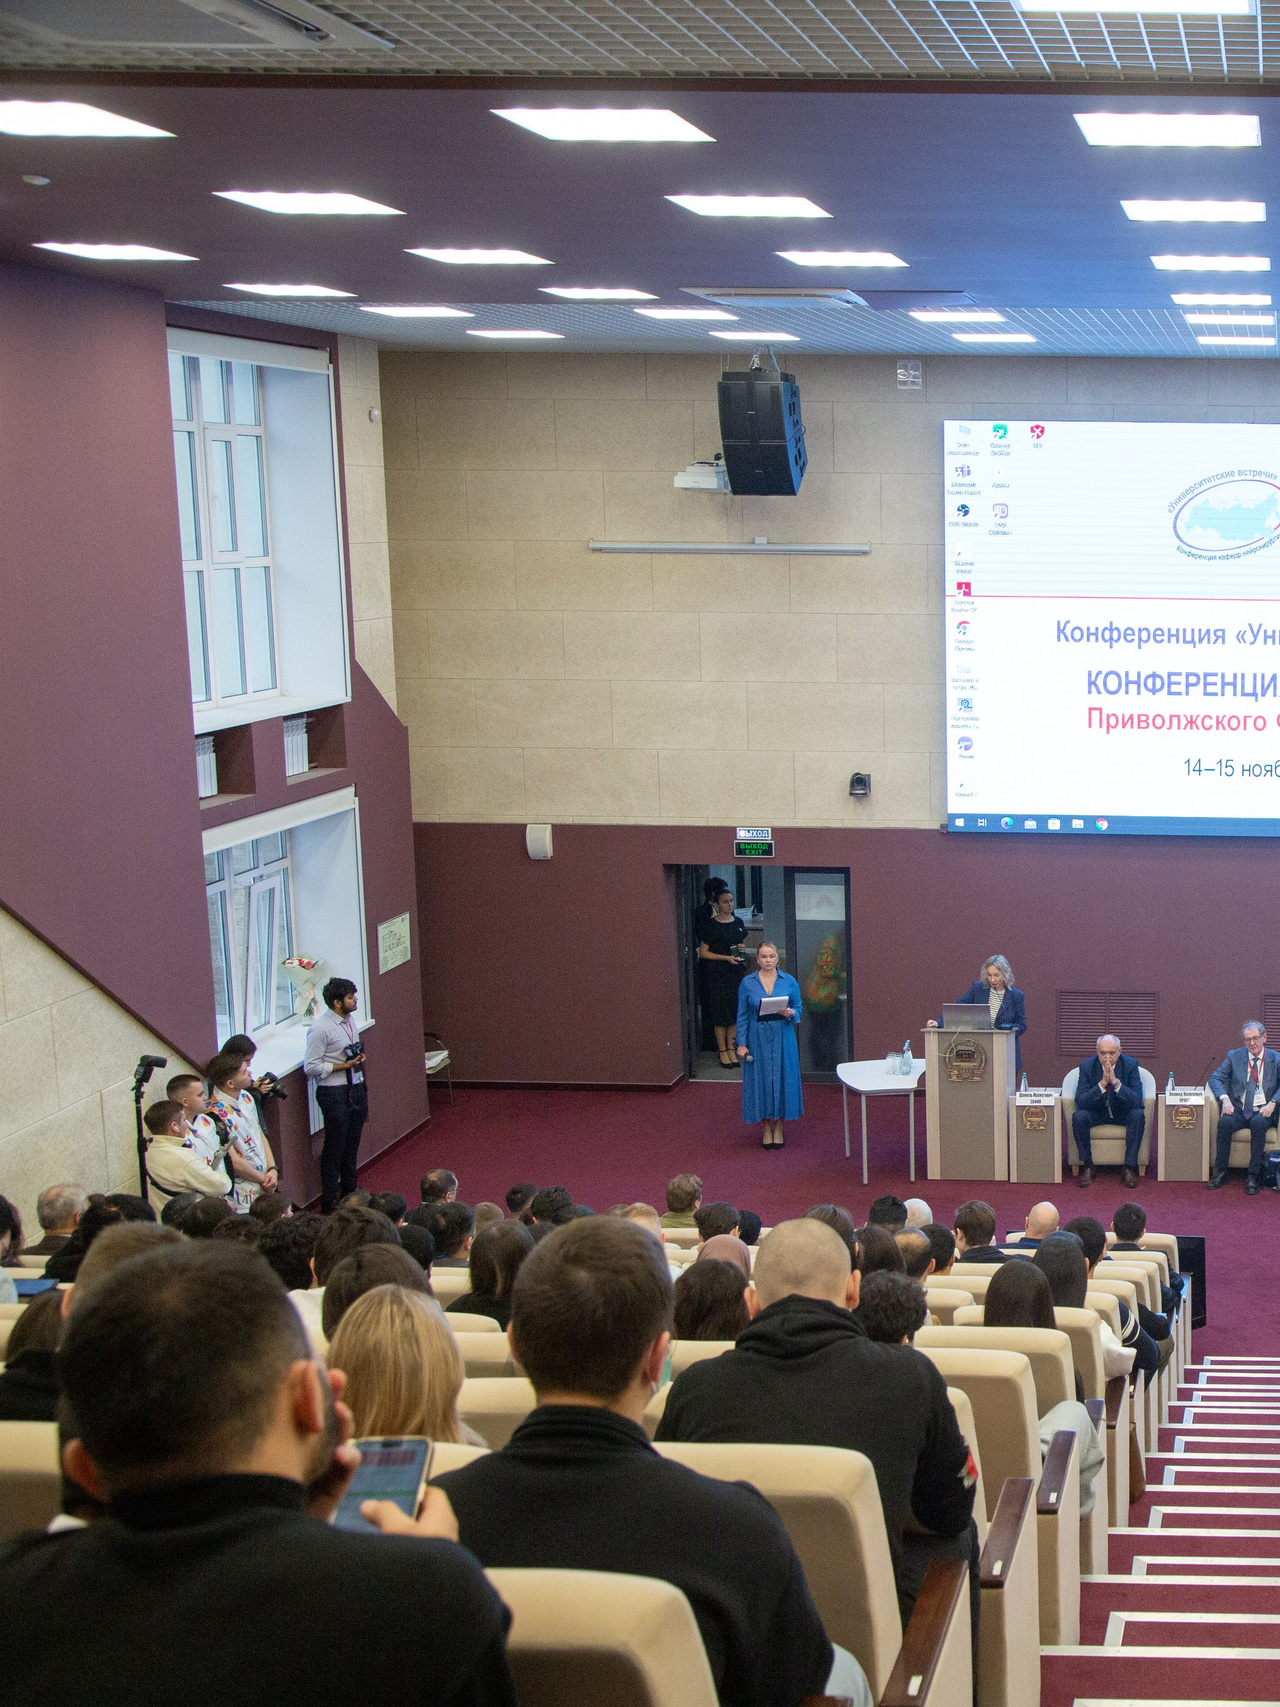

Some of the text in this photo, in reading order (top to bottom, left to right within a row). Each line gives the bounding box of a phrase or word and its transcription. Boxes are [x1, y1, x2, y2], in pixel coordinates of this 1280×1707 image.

[1238, 469, 1277, 480] встречи»
[1056, 620, 1226, 649] Конференция
[1088, 707, 1267, 734] Приволжского
